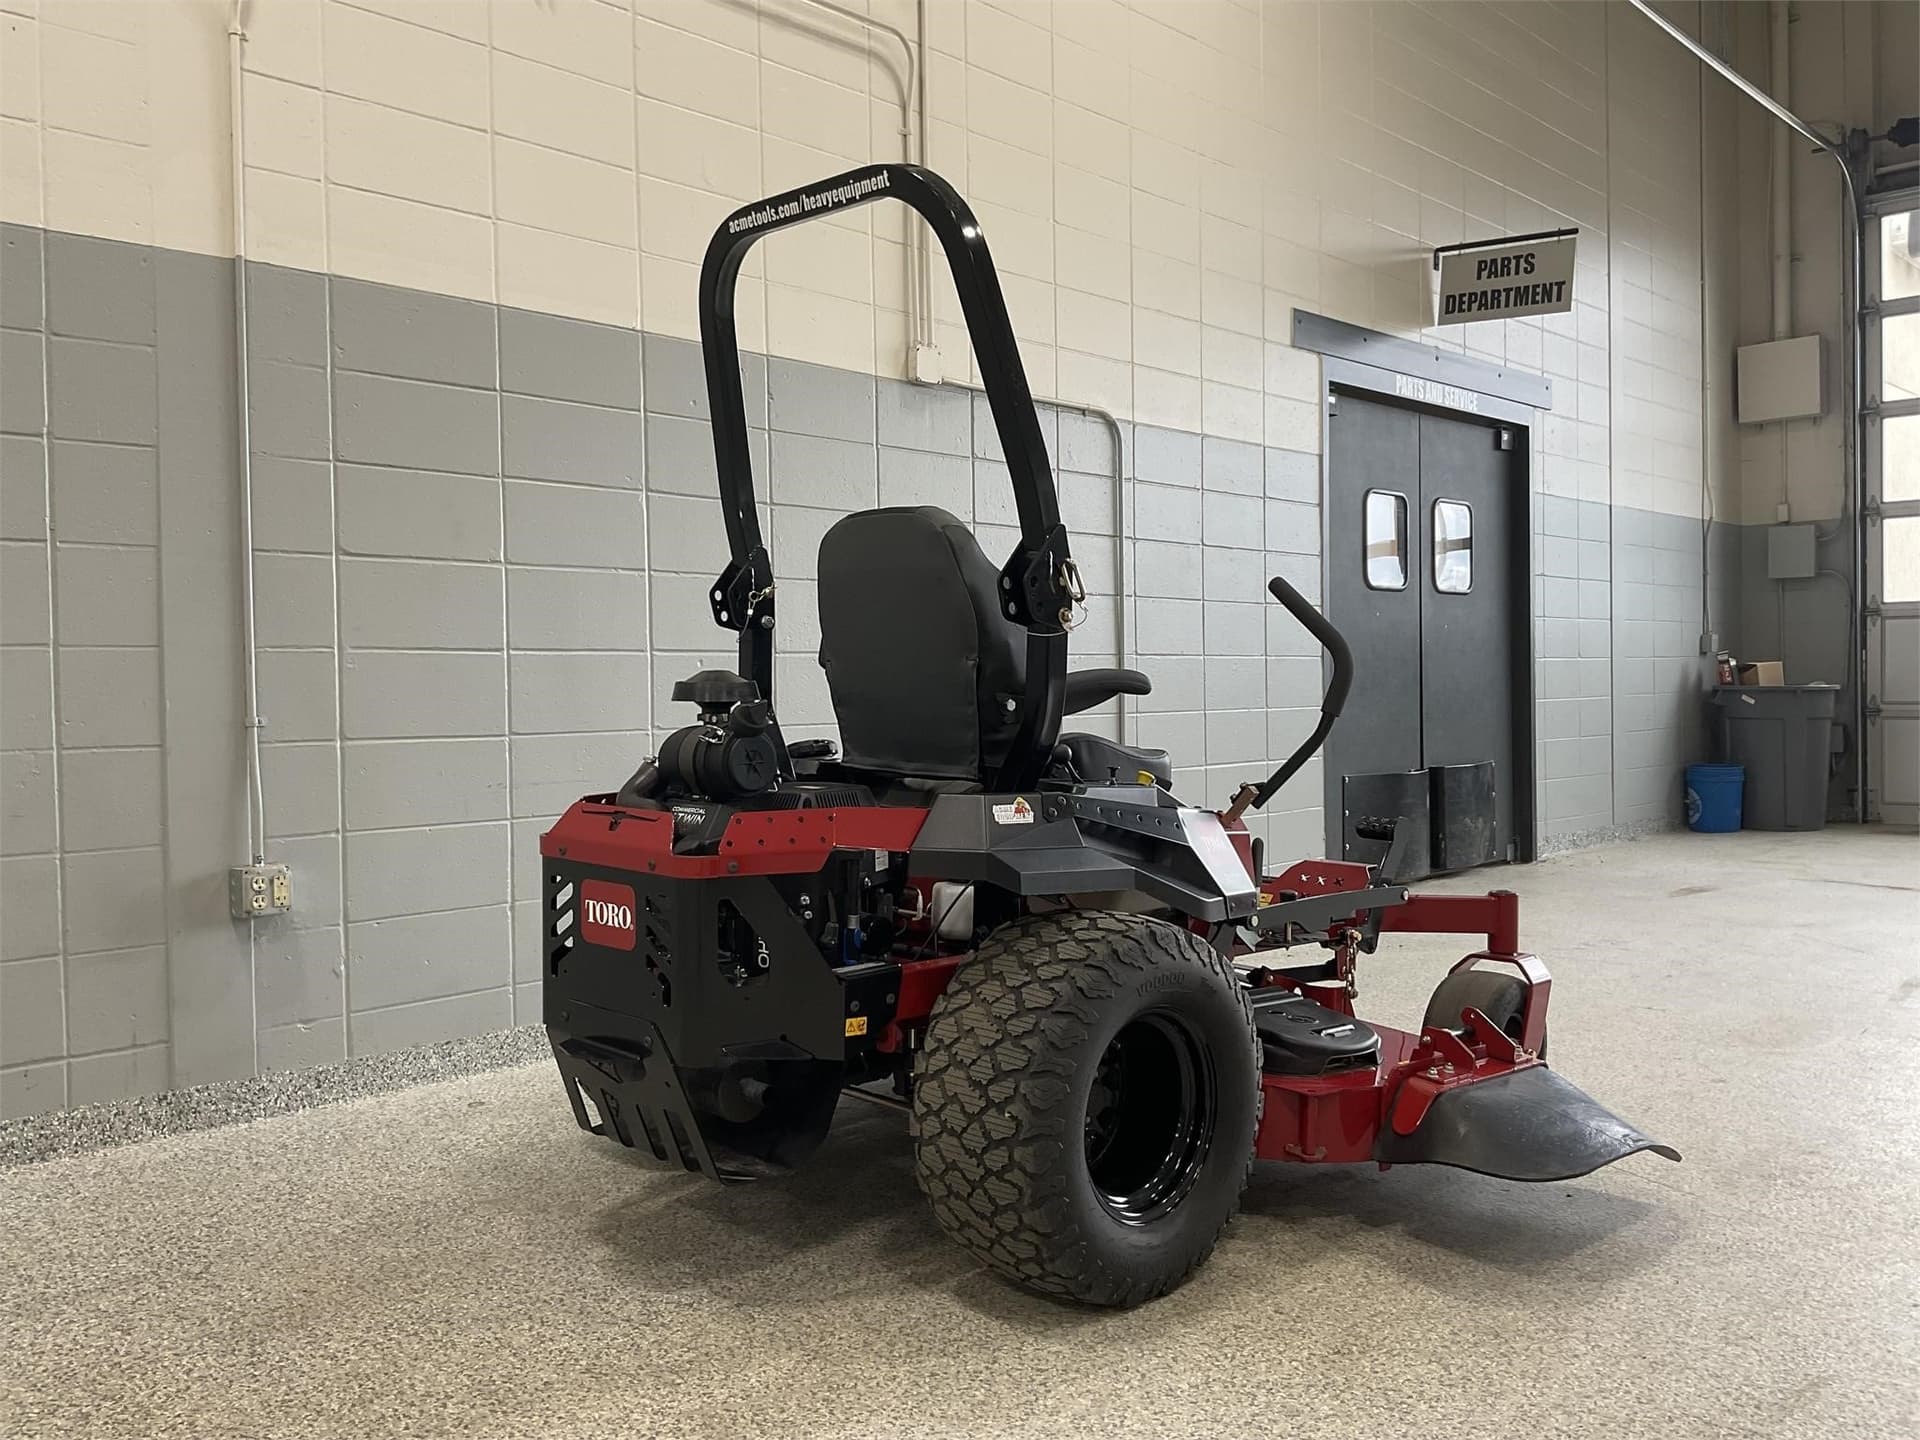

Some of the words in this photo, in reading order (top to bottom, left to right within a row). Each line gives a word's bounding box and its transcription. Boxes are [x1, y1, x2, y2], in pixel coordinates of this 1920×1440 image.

[728, 169, 890, 234] acmetools.com/heavyequipment
[1476, 252, 1536, 281] PARTS
[1444, 280, 1567, 315] DEPARTMENT
[1395, 374, 1424, 399] PARTS
[1425, 381, 1443, 403] AND
[1444, 386, 1478, 411] SERVICE
[585, 899, 633, 930] TORO
